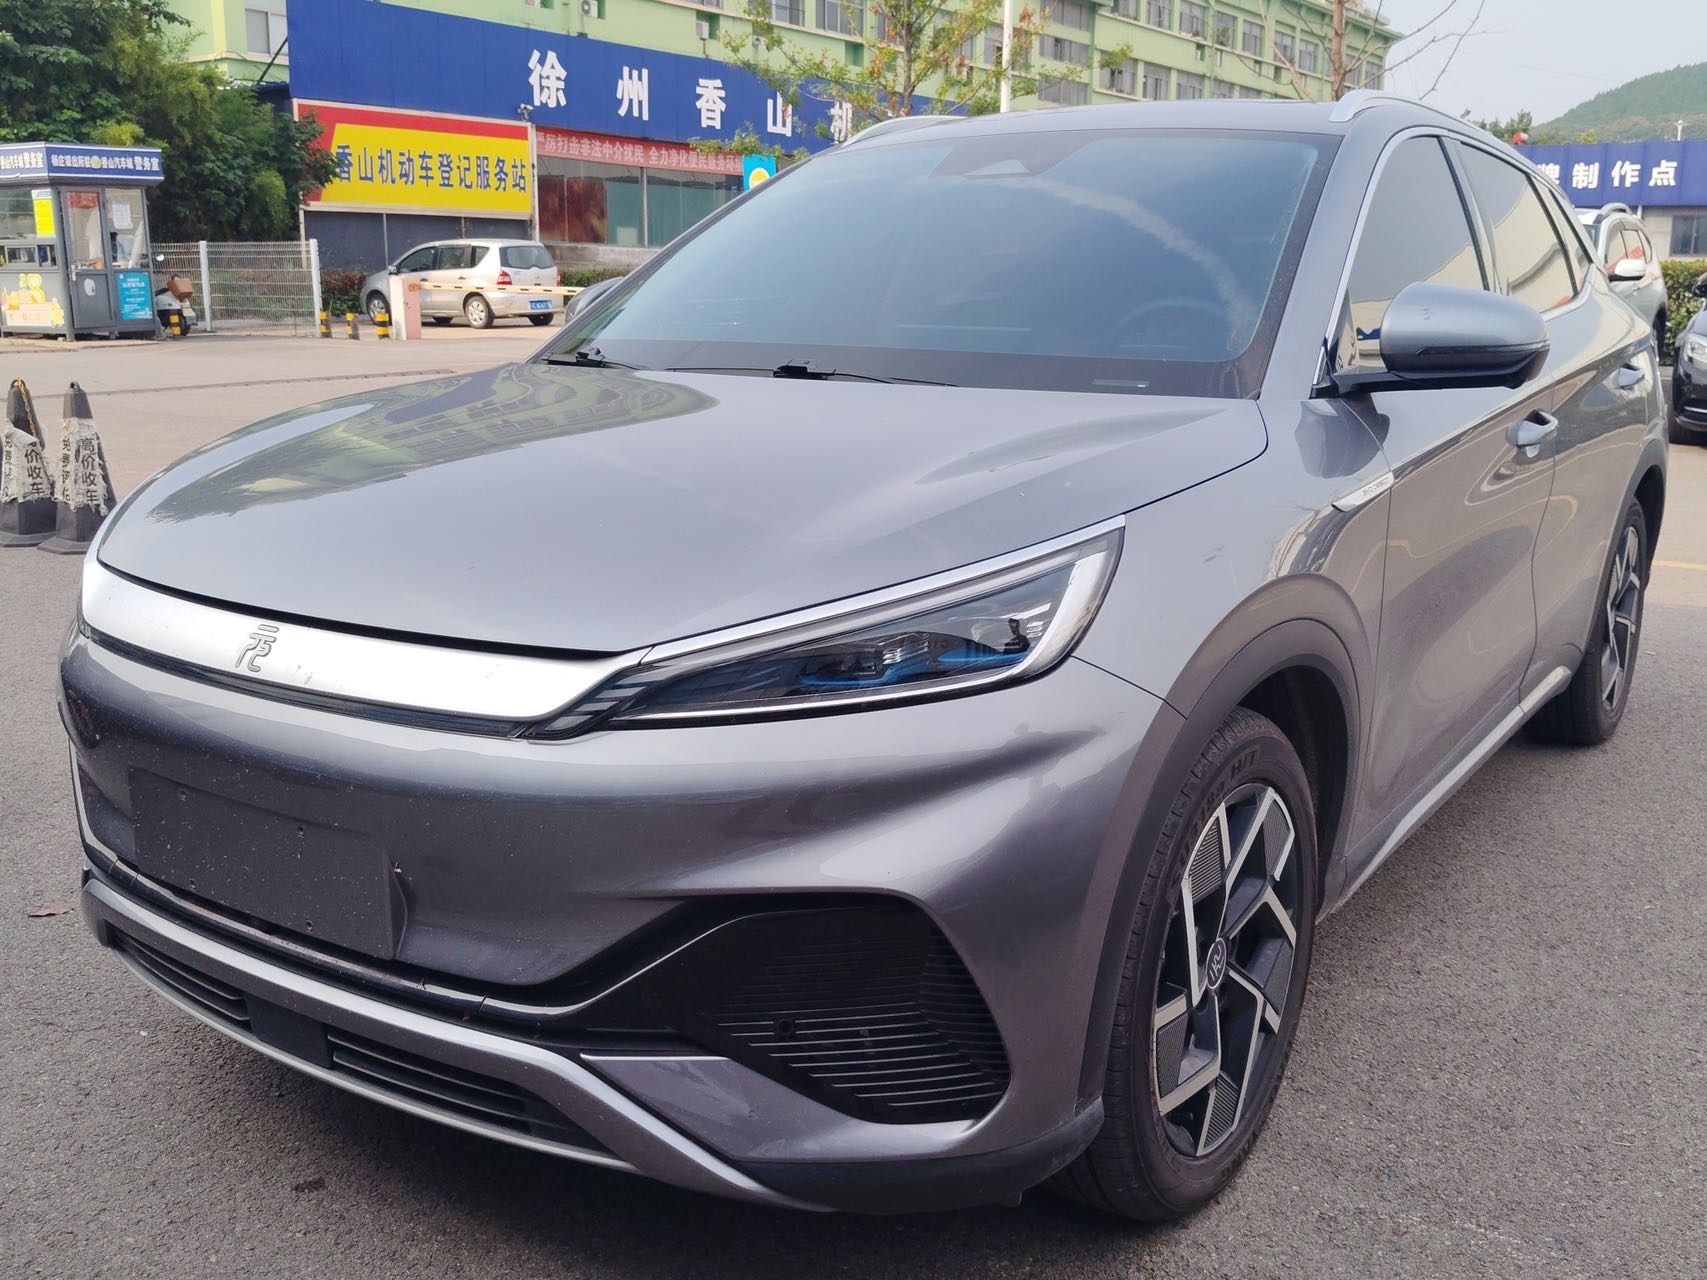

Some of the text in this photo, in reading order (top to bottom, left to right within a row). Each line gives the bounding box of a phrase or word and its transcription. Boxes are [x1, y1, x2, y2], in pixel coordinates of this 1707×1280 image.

[335, 144, 527, 193] 香山机动车登记服务站
[25, 441, 45, 499] 价收车
[80, 438, 99, 504] 高价收车
